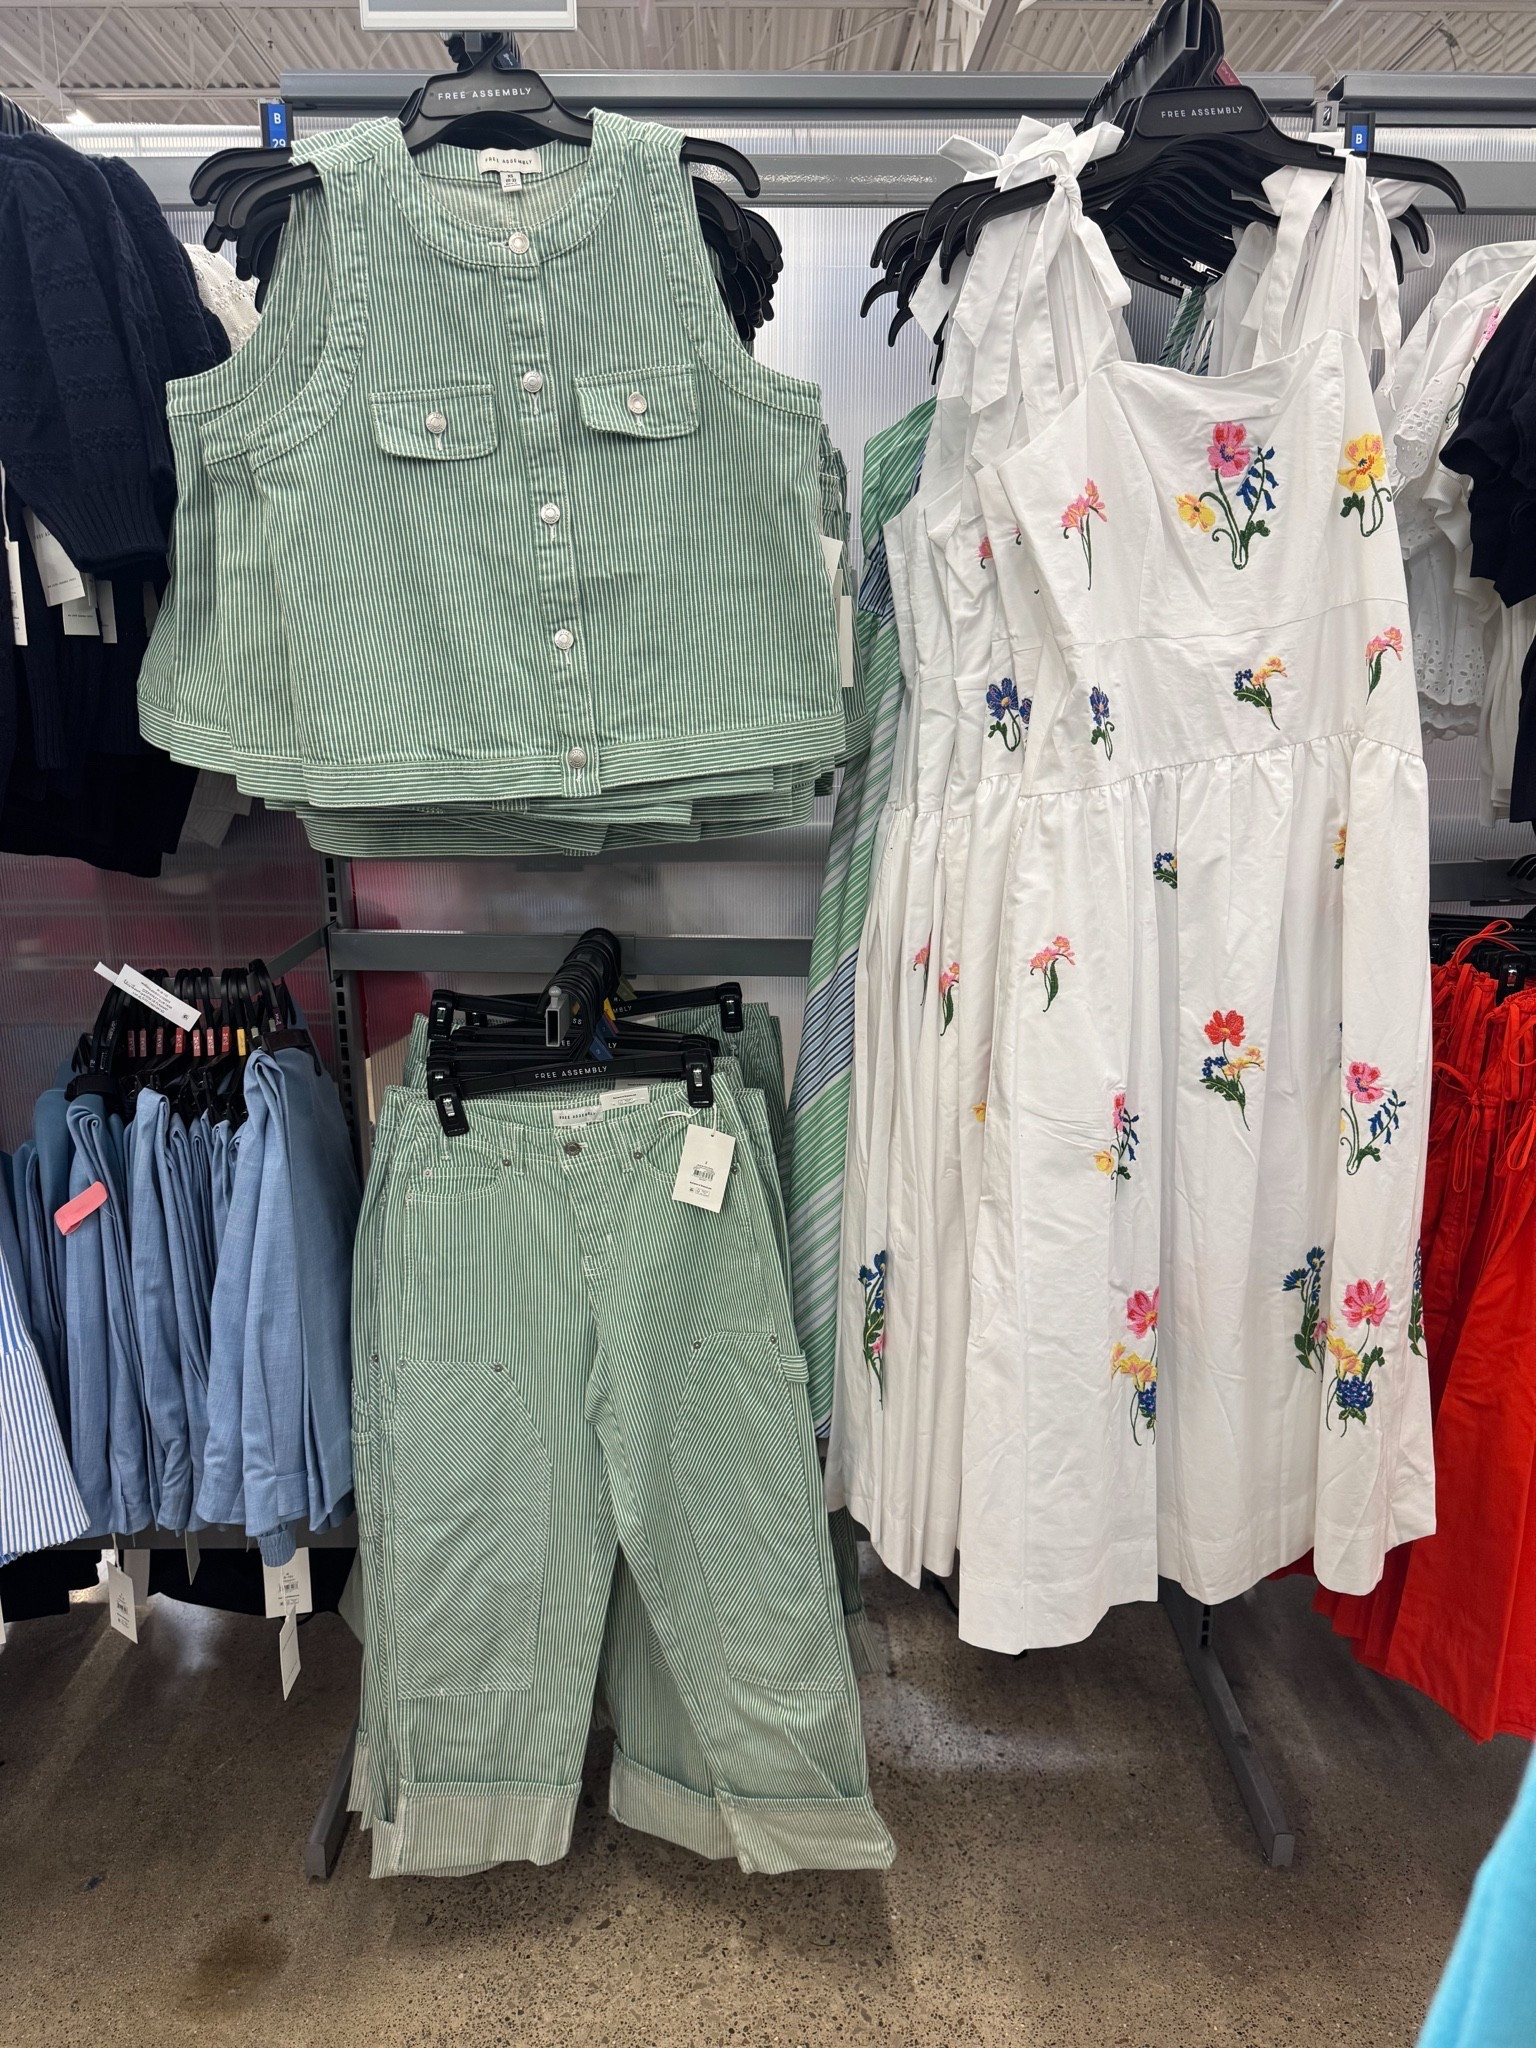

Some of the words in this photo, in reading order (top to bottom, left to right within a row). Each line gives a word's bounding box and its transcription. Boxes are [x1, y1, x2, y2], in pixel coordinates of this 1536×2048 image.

[438, 91, 466, 100] FREE
[472, 87, 532, 98] ASSEMBLY
[1161, 110, 1186, 118] FREE
[1191, 106, 1243, 116] ASSEMBLY
[273, 112, 282, 125] B
[272, 138, 286, 148] 29
[1355, 133, 1363, 145] B
[534, 1071, 557, 1079] FREE
[562, 1066, 607, 1077] ASSEMBLY
